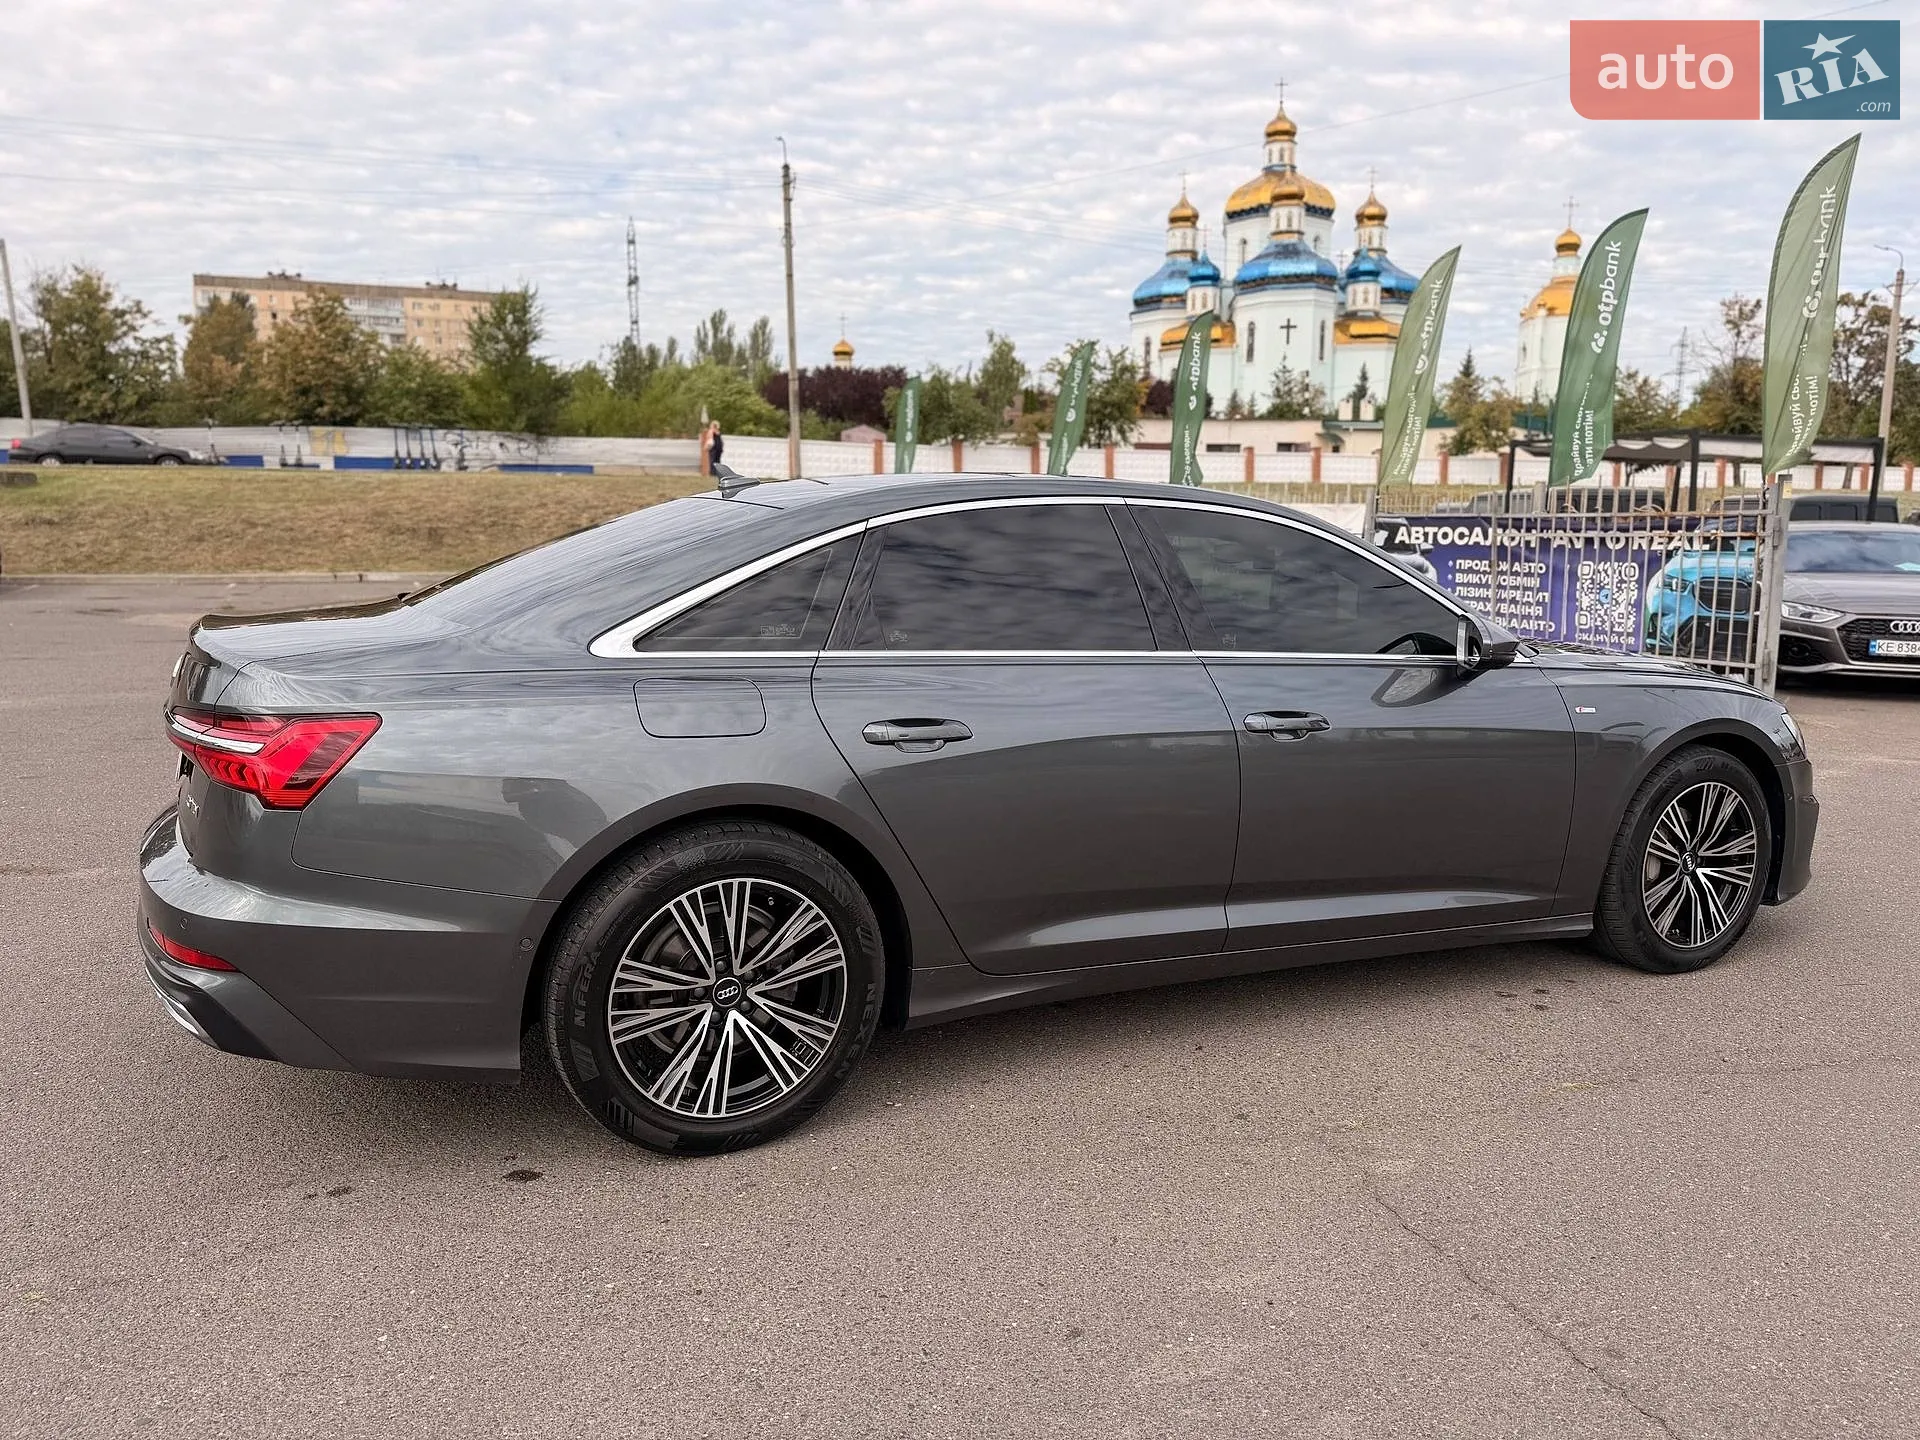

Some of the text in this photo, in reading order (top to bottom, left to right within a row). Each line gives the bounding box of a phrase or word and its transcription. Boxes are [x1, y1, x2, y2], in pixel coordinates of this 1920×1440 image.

[1598, 240, 1622, 326] otpbank
[1583, 410, 1594, 444] потім!
[1456, 559, 1508, 573] ПРОДЖ
